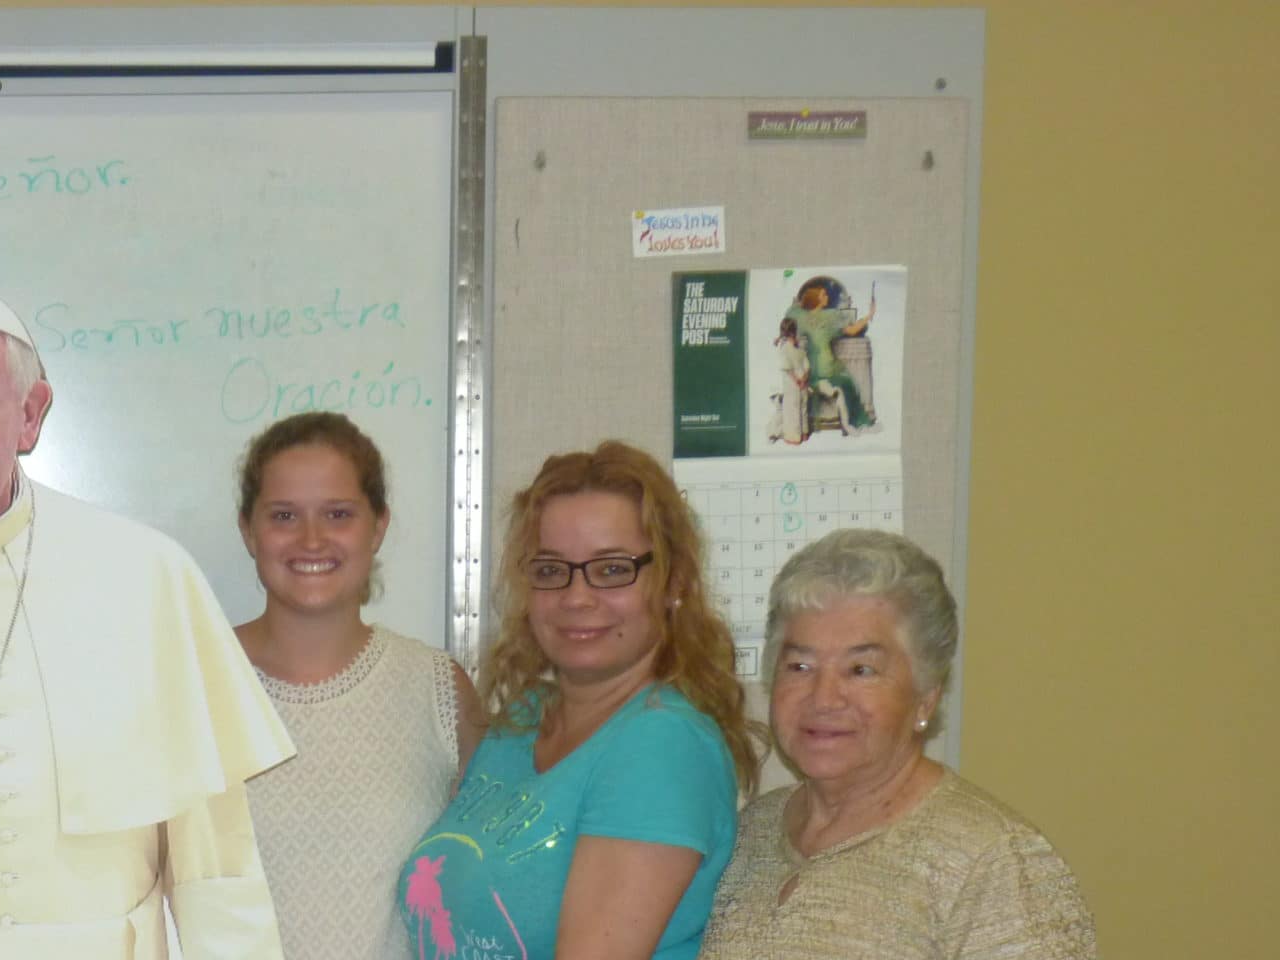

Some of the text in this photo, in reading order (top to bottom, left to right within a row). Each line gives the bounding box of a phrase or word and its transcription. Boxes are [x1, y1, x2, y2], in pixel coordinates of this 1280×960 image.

[686, 282, 705, 297] THE
[205, 288, 408, 339] nuestra
[683, 296, 739, 313] SATURDAY
[682, 311, 727, 330] EVENING
[681, 329, 710, 346] POST
[221, 357, 433, 424] Oración.
